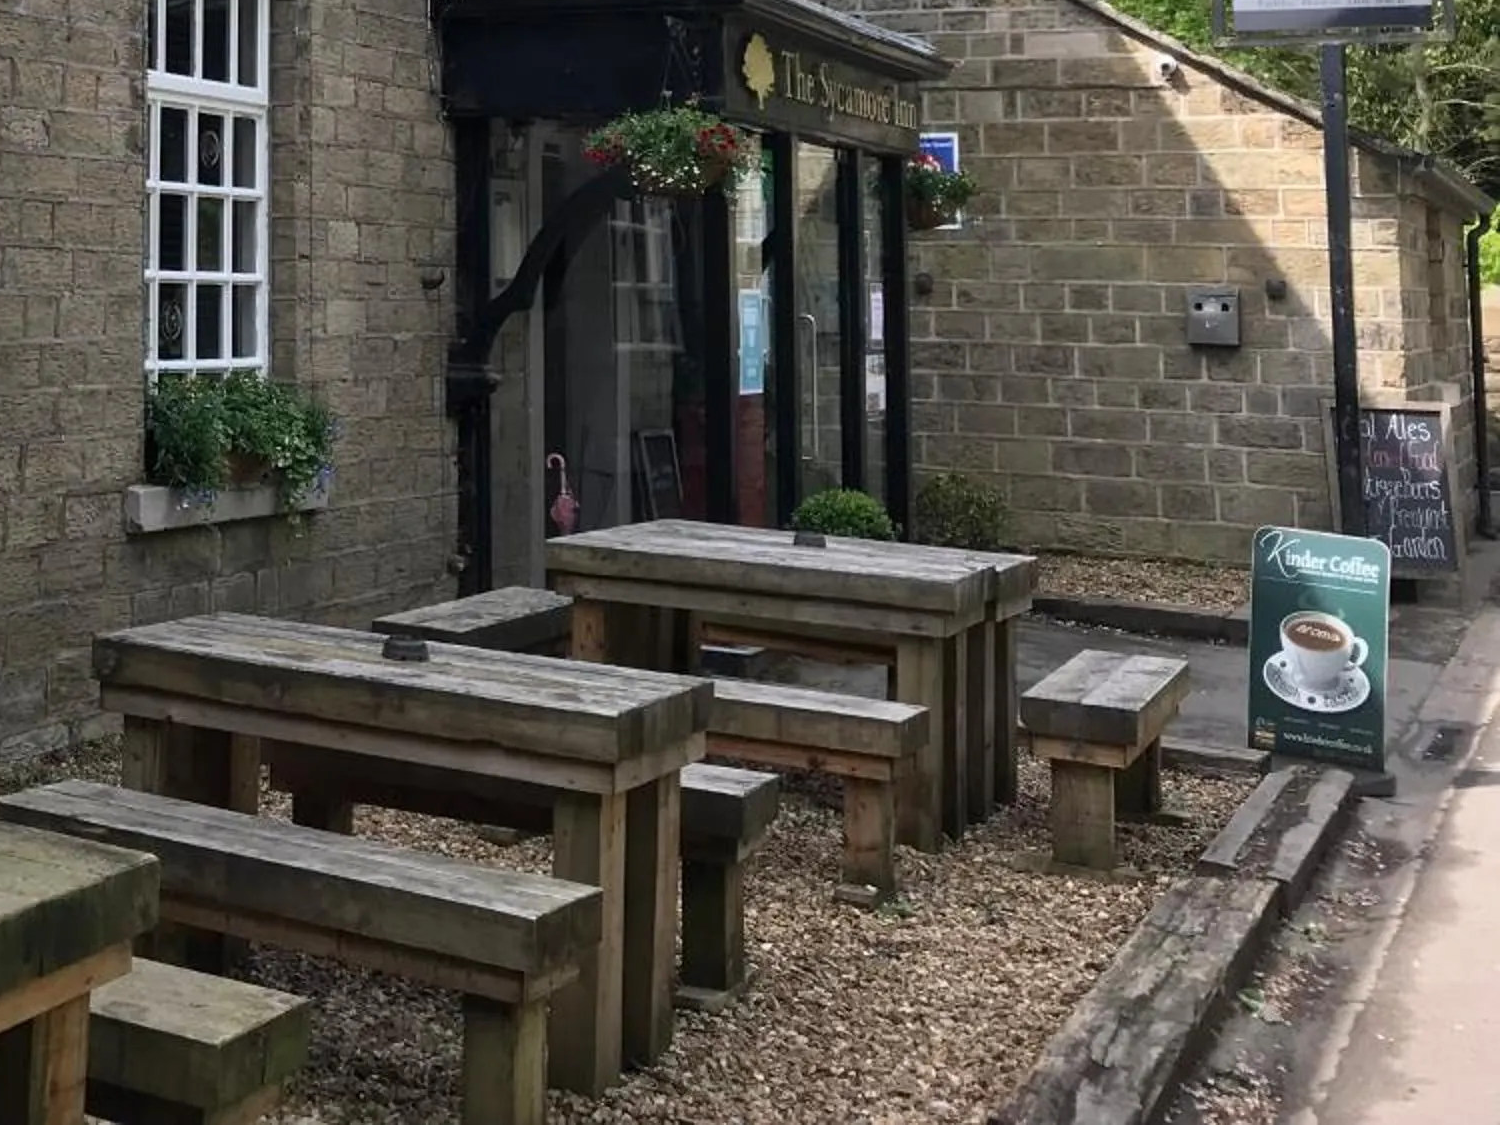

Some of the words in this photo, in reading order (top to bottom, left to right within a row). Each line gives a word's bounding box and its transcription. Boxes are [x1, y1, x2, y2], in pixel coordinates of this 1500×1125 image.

[781, 49, 815, 106] The
[820, 62, 891, 124] Sycamore
[893, 83, 918, 130] Inn
[1385, 412, 1431, 442] Ales
[1260, 530, 1327, 578] Kinder
[1329, 554, 1380, 579] Coffee
